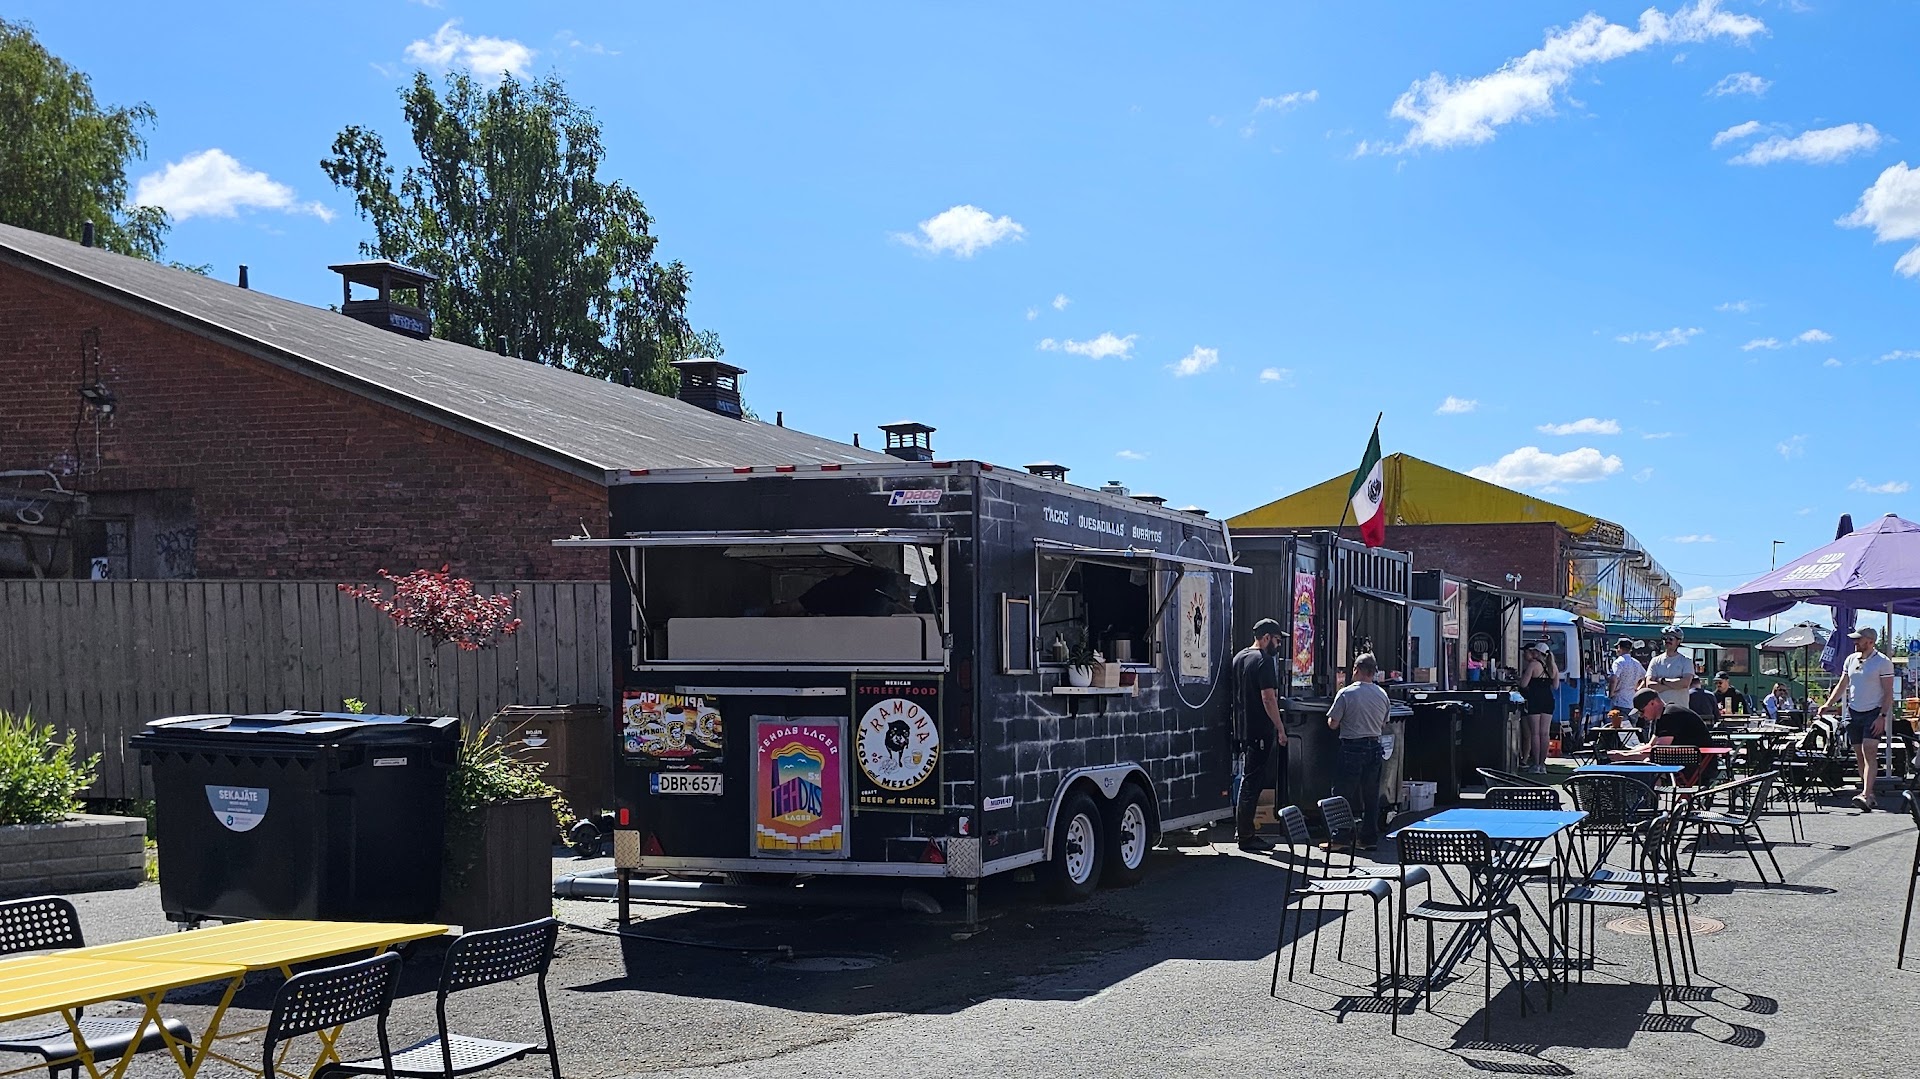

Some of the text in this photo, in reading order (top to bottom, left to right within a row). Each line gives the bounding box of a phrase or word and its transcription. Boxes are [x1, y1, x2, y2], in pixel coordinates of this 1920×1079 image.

[902, 490, 942, 504] pace
[1043, 505, 1162, 543] TACOS QUESADILLAS BURRITOS
[1789, 562, 1843, 575] HARD
[859, 686, 937, 695] STREET FOOD
[870, 700, 930, 744] RAMONA
[758, 726, 839, 755] TEHDAS LAGER
[858, 728, 869, 766] TACOS
[881, 745, 939, 788] MEZCALERIA
[218, 789, 258, 802] SEKAJÄTE
[771, 777, 823, 818] TEHDAS
[860, 796, 883, 804] BEER
[899, 797, 936, 806] DRINKS
